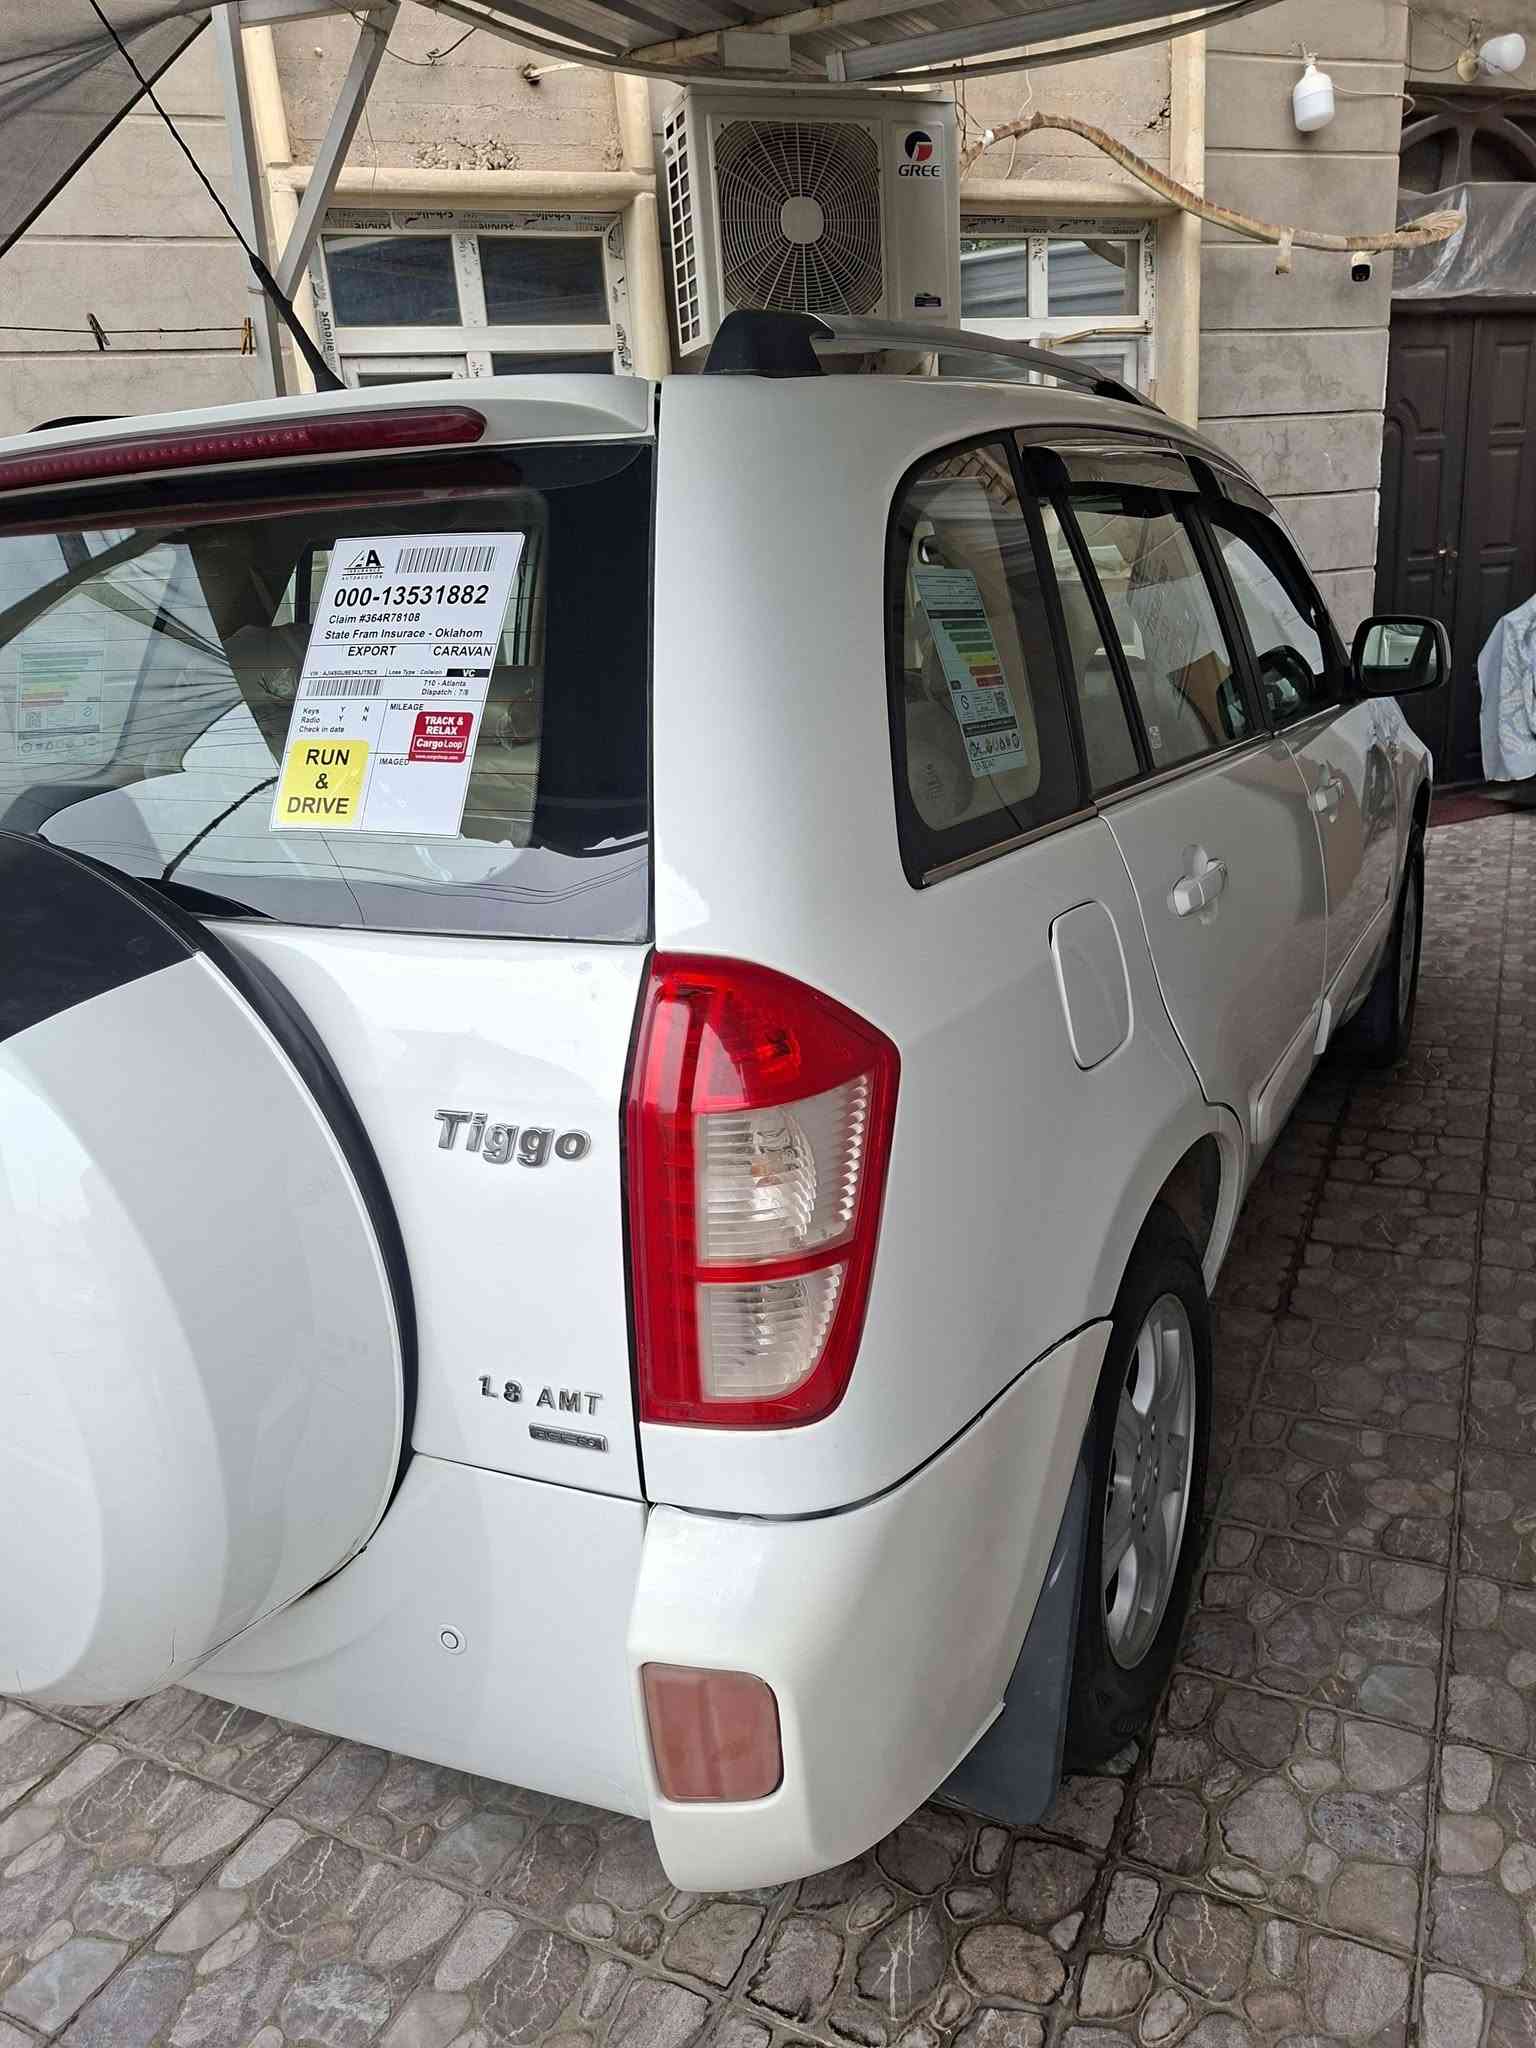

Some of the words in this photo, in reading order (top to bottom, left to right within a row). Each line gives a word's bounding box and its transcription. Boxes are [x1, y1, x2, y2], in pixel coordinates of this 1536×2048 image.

[898, 164, 941, 177] GREE
[334, 585, 490, 607] 000-13531882
[328, 615, 357, 625] Claim
[359, 612, 421, 623] #364R78108
[324, 630, 350, 640] State
[352, 629, 378, 639] Fram
[380, 628, 425, 638] Insurace
[435, 627, 483, 638] Oklahom
[347, 645, 397, 657] EXPORT
[433, 645, 493, 657] CARAVAN
[421, 688, 452, 696] Dispatch
[303, 707, 320, 716] Keys
[389, 703, 425, 711] MILEAGE
[301, 716, 321, 724] Radio
[425, 716, 456, 726] TRACK
[426, 725, 458, 736] RELAX
[306, 749, 350, 766] RUN
[379, 758, 409, 766] IMAGED
[316, 773, 329, 789] &
[287, 796, 350, 815] DRIVE
[434, 1109, 592, 1168] Tiggo
[535, 1386, 605, 1416] AMT
